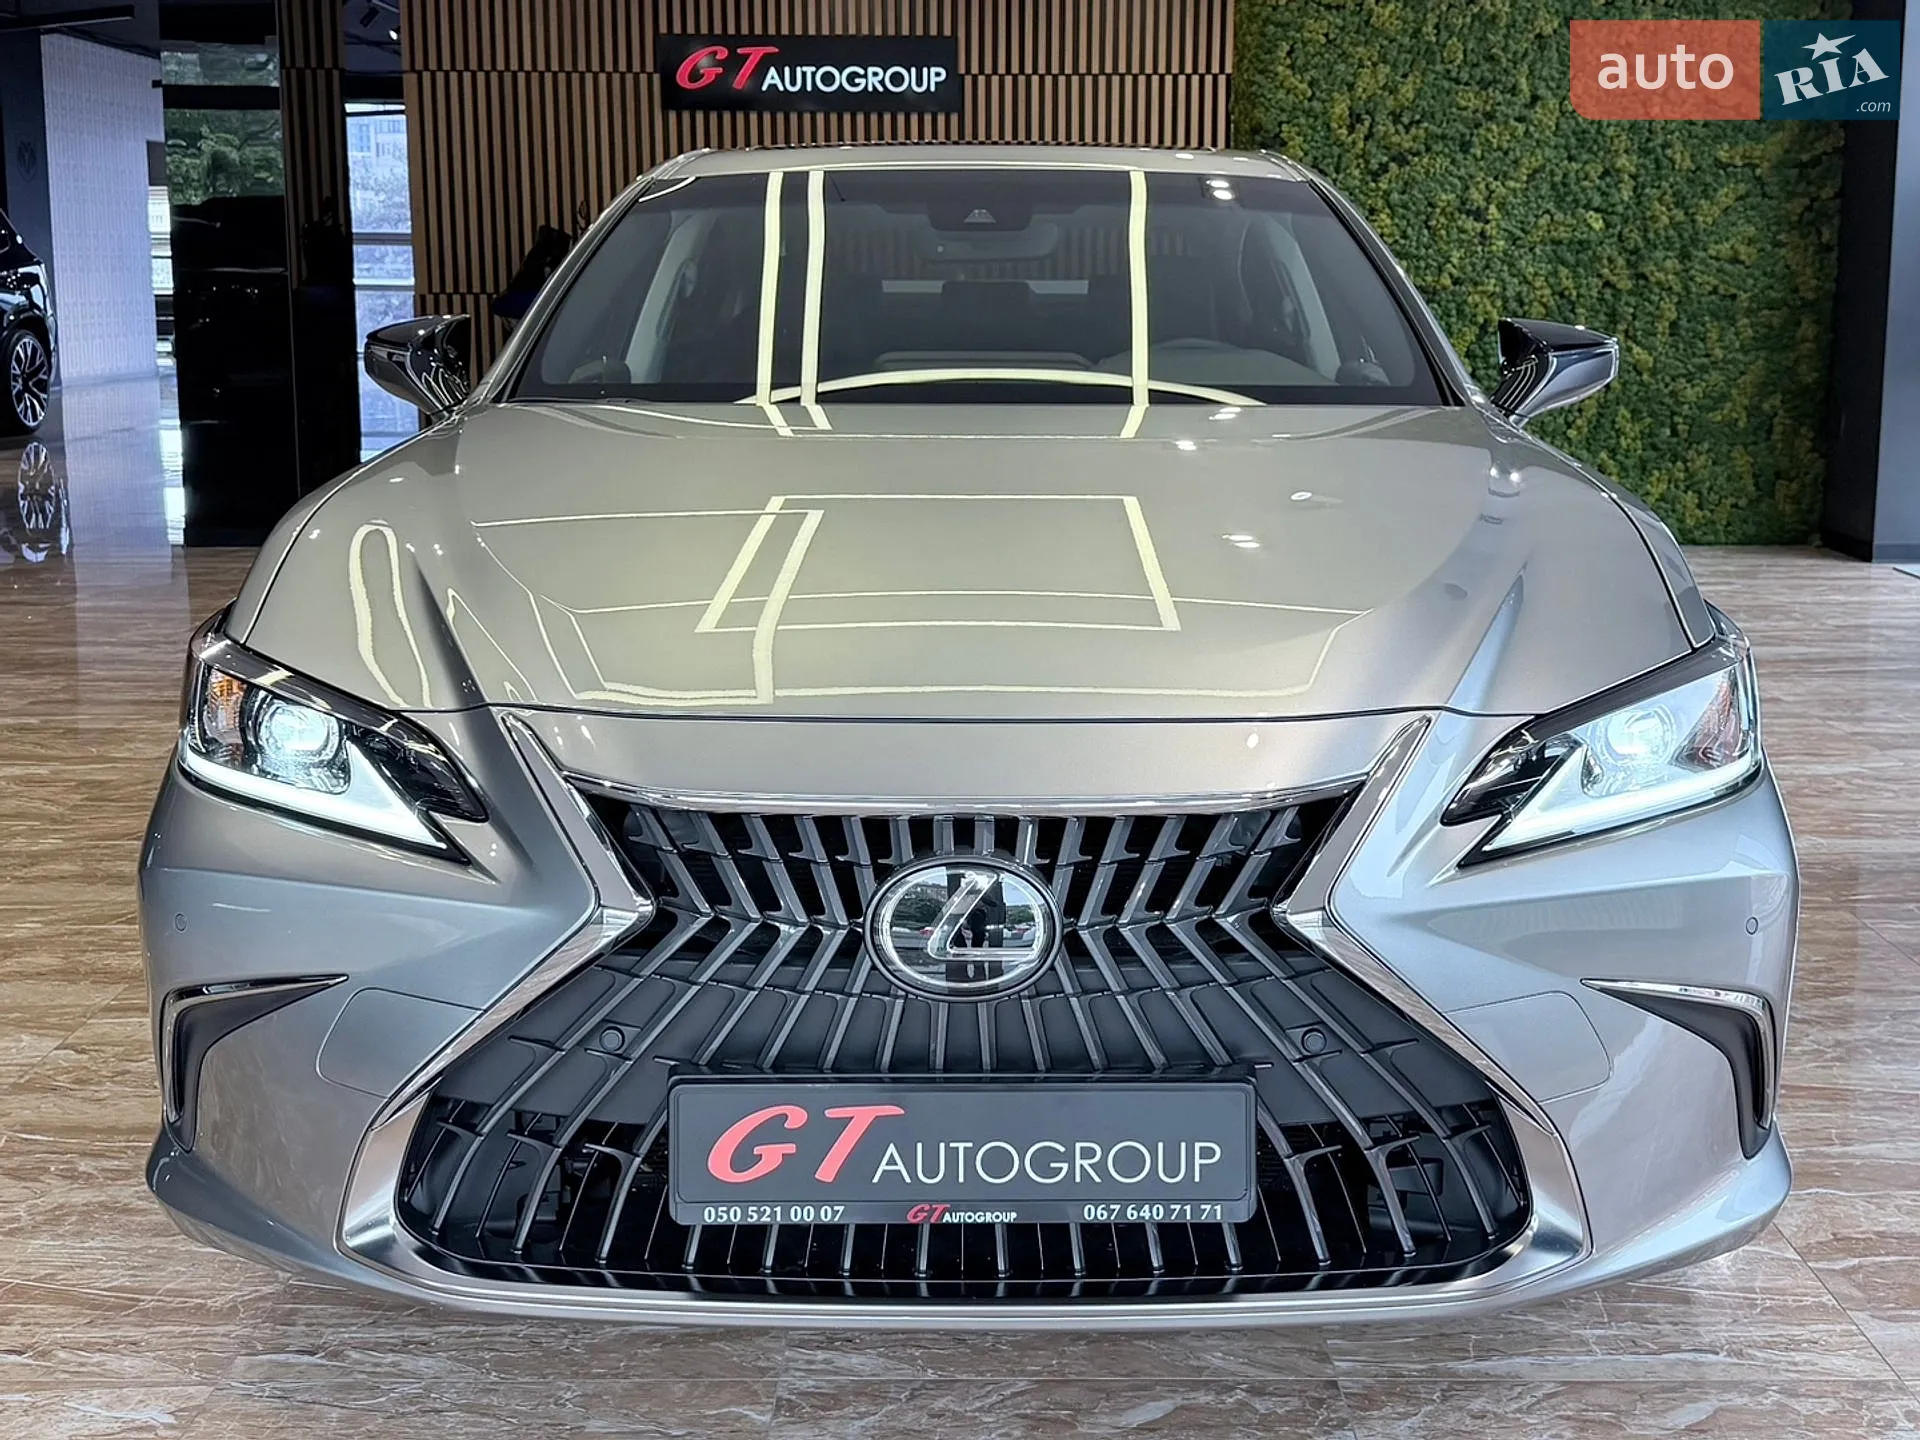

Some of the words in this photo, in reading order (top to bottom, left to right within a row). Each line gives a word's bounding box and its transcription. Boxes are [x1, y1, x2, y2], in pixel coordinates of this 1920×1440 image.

[675, 45, 780, 91] GT
[761, 65, 948, 93] AUTOGROUP
[705, 1104, 906, 1184] GT
[871, 1140, 1222, 1184] AUTOGROUP
[703, 1205, 742, 1223] 050
[746, 1205, 782, 1223] 521
[790, 1205, 816, 1222] 00
[820, 1205, 846, 1222] 07
[906, 1203, 951, 1224] GT
[942, 1211, 1018, 1223] AUTOGROUP
[1083, 1204, 1119, 1221] 067
[1126, 1204, 1165, 1221] 640
[1170, 1204, 1193, 1221] 71
[1199, 1204, 1223, 1220] 71
